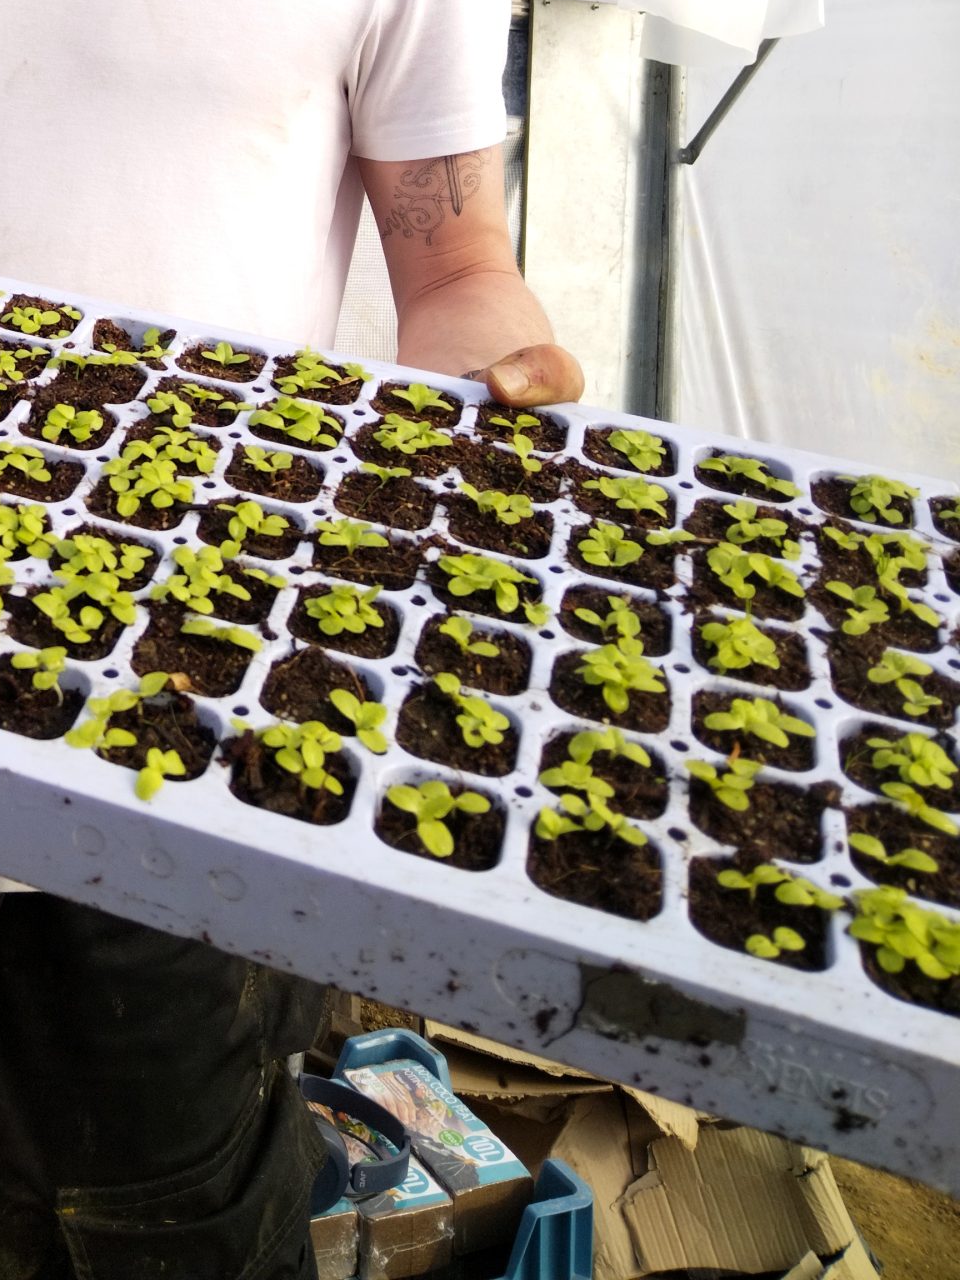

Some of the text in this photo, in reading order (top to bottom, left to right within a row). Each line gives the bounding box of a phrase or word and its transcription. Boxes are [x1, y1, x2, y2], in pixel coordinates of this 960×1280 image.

[430, 1081, 457, 1105] COCO
[453, 1103, 479, 1123] PEAT
[467, 1137, 501, 1161] 10L
[359, 1171, 367, 1188] JVC
